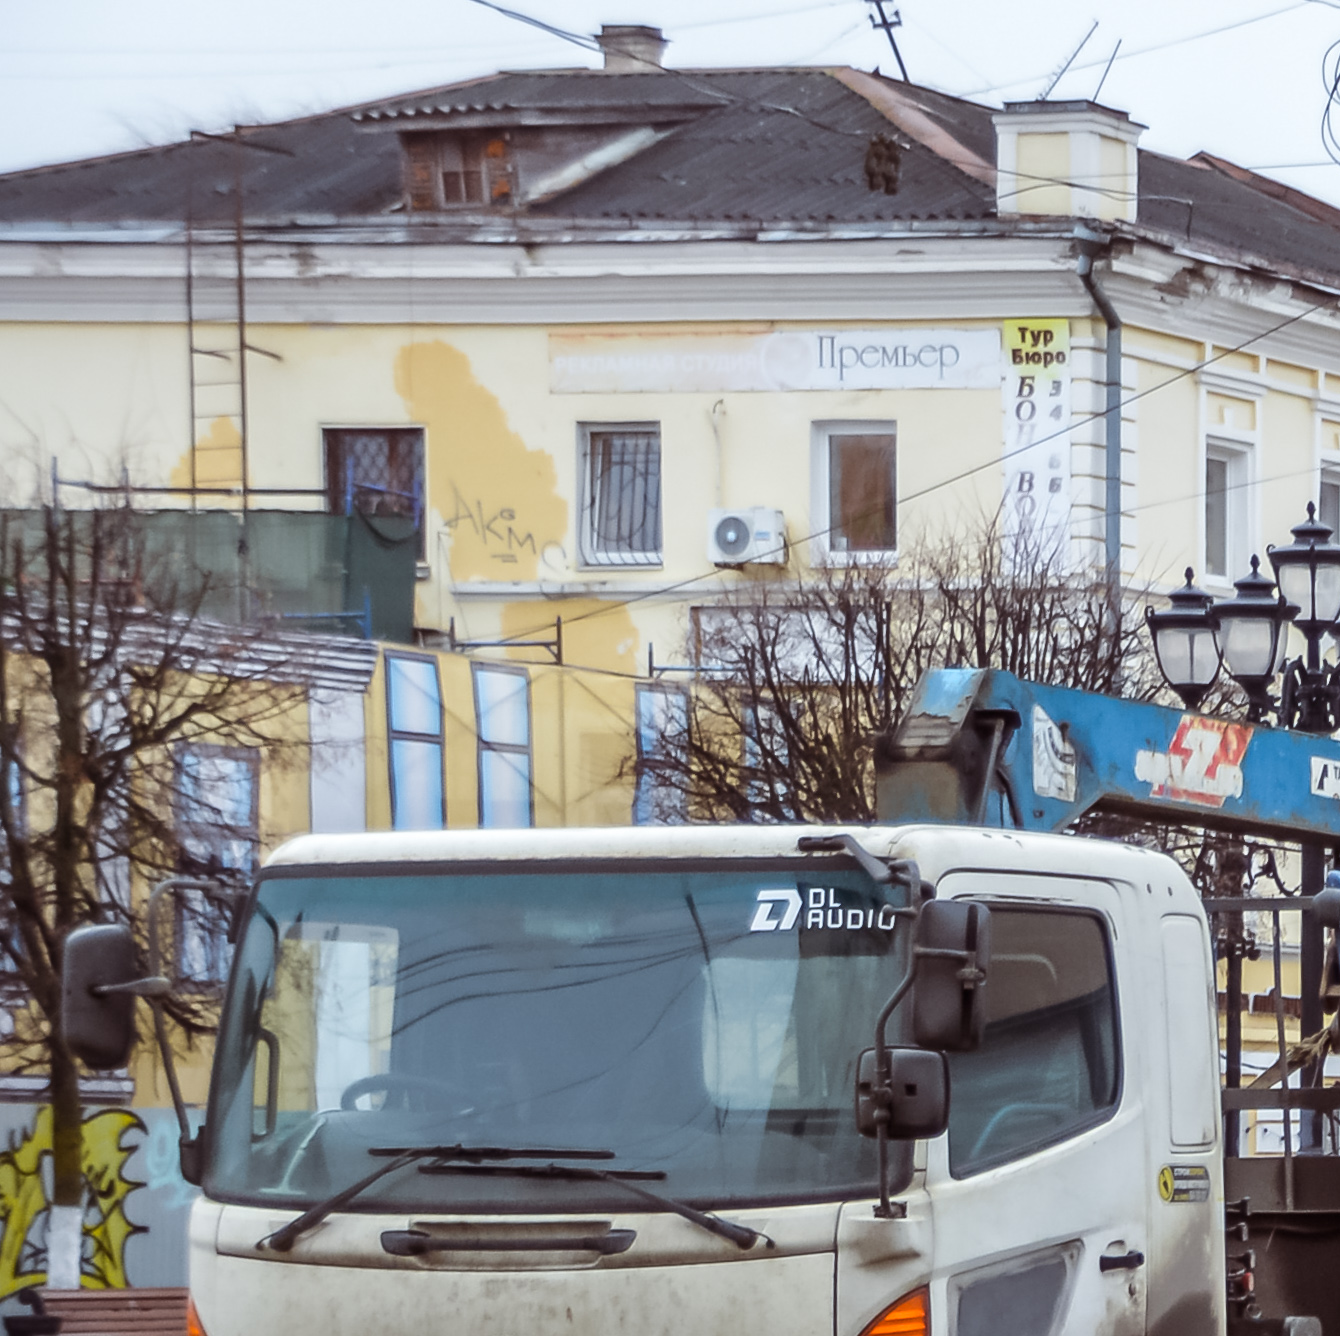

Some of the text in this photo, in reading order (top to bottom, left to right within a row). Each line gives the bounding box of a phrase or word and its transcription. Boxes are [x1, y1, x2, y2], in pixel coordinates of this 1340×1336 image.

[1017, 326, 1055, 348] Тур
[817, 335, 960, 380] Премьер
[1010, 348, 1067, 369] Бюро
[808, 887, 842, 908] DL
[806, 908, 896, 931] AUDIO
